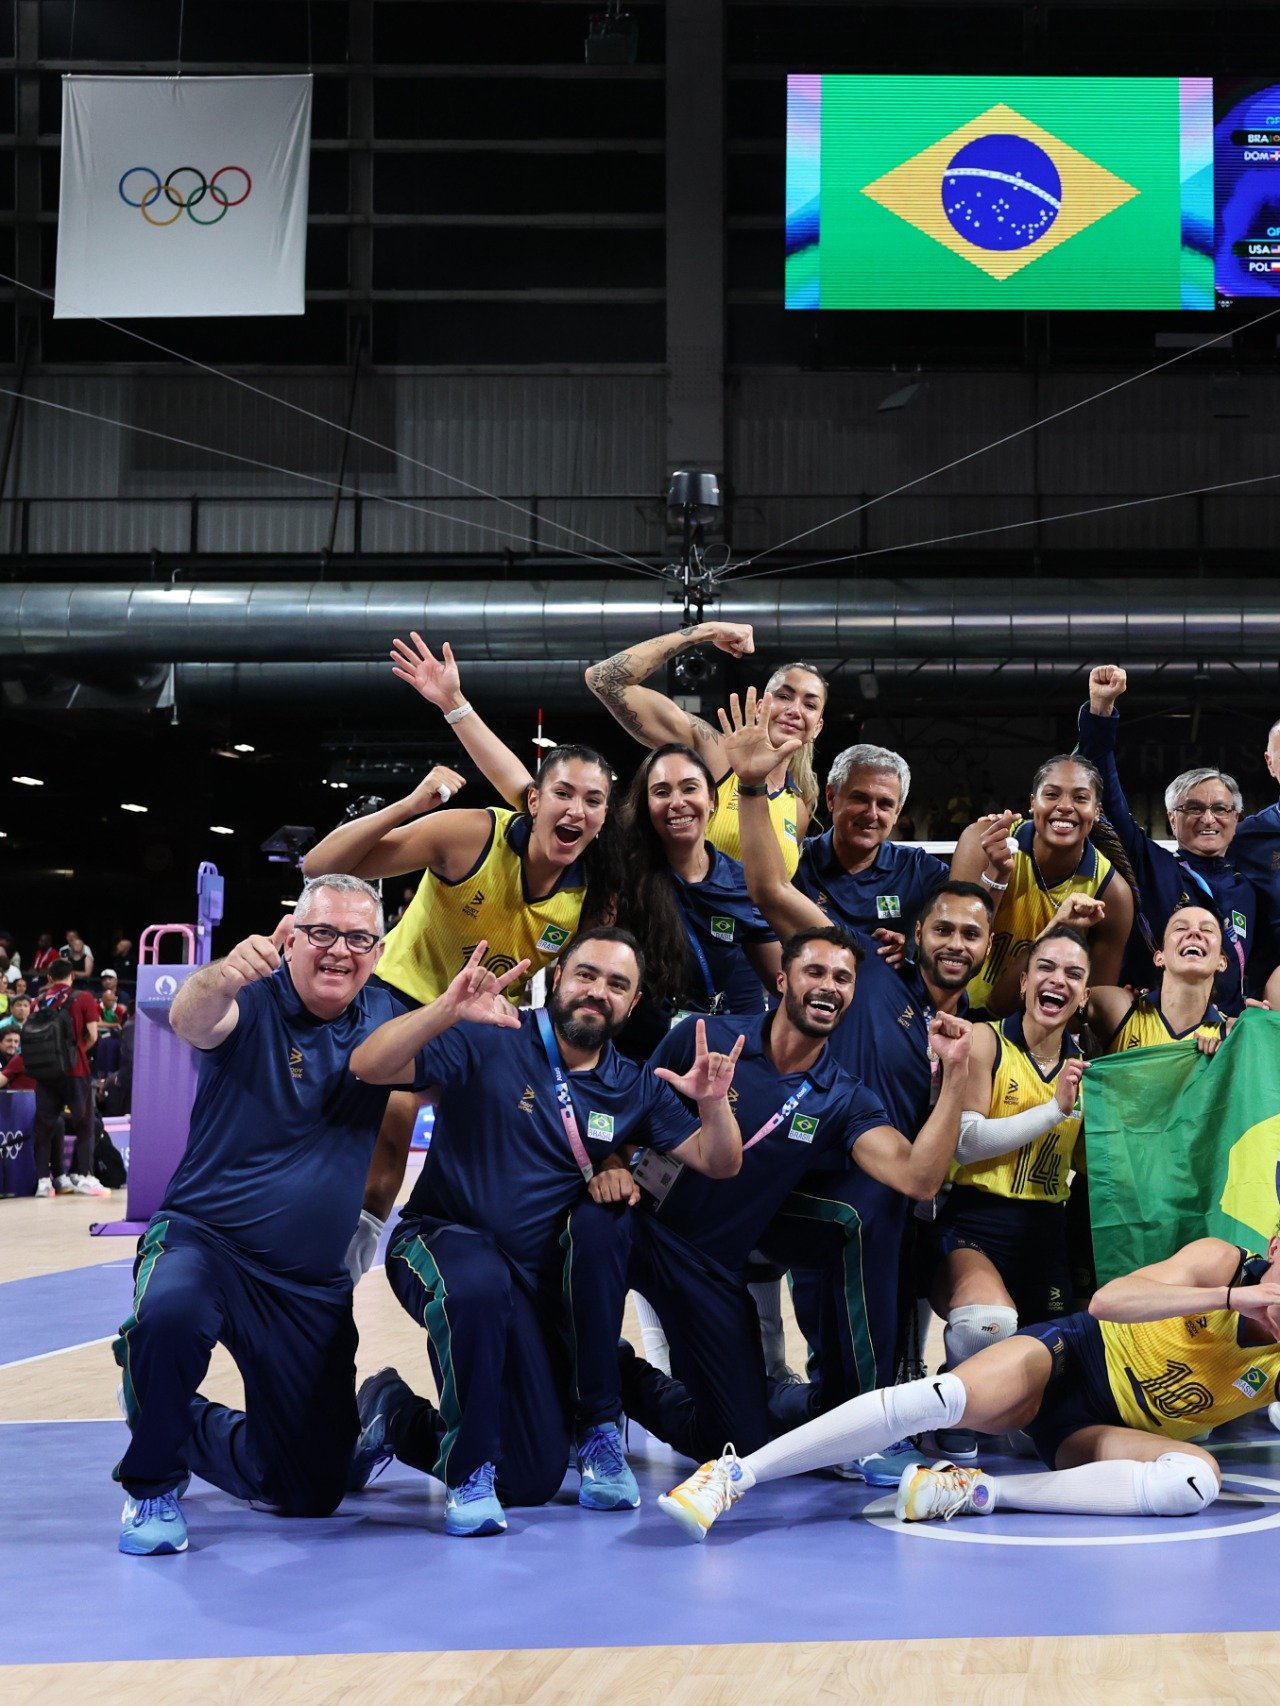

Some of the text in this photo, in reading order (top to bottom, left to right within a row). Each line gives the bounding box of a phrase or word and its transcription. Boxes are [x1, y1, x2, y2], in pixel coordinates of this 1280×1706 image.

[1248, 134, 1270, 143] BRA
[1244, 152, 1270, 161] DOM
[1248, 245, 1270, 254] USA
[1249, 262, 1270, 272] POL
[588, 1130, 613, 1142] BRASIL
[789, 1130, 812, 1142] BRASIL
[1010, 1132, 1062, 1196] 14
